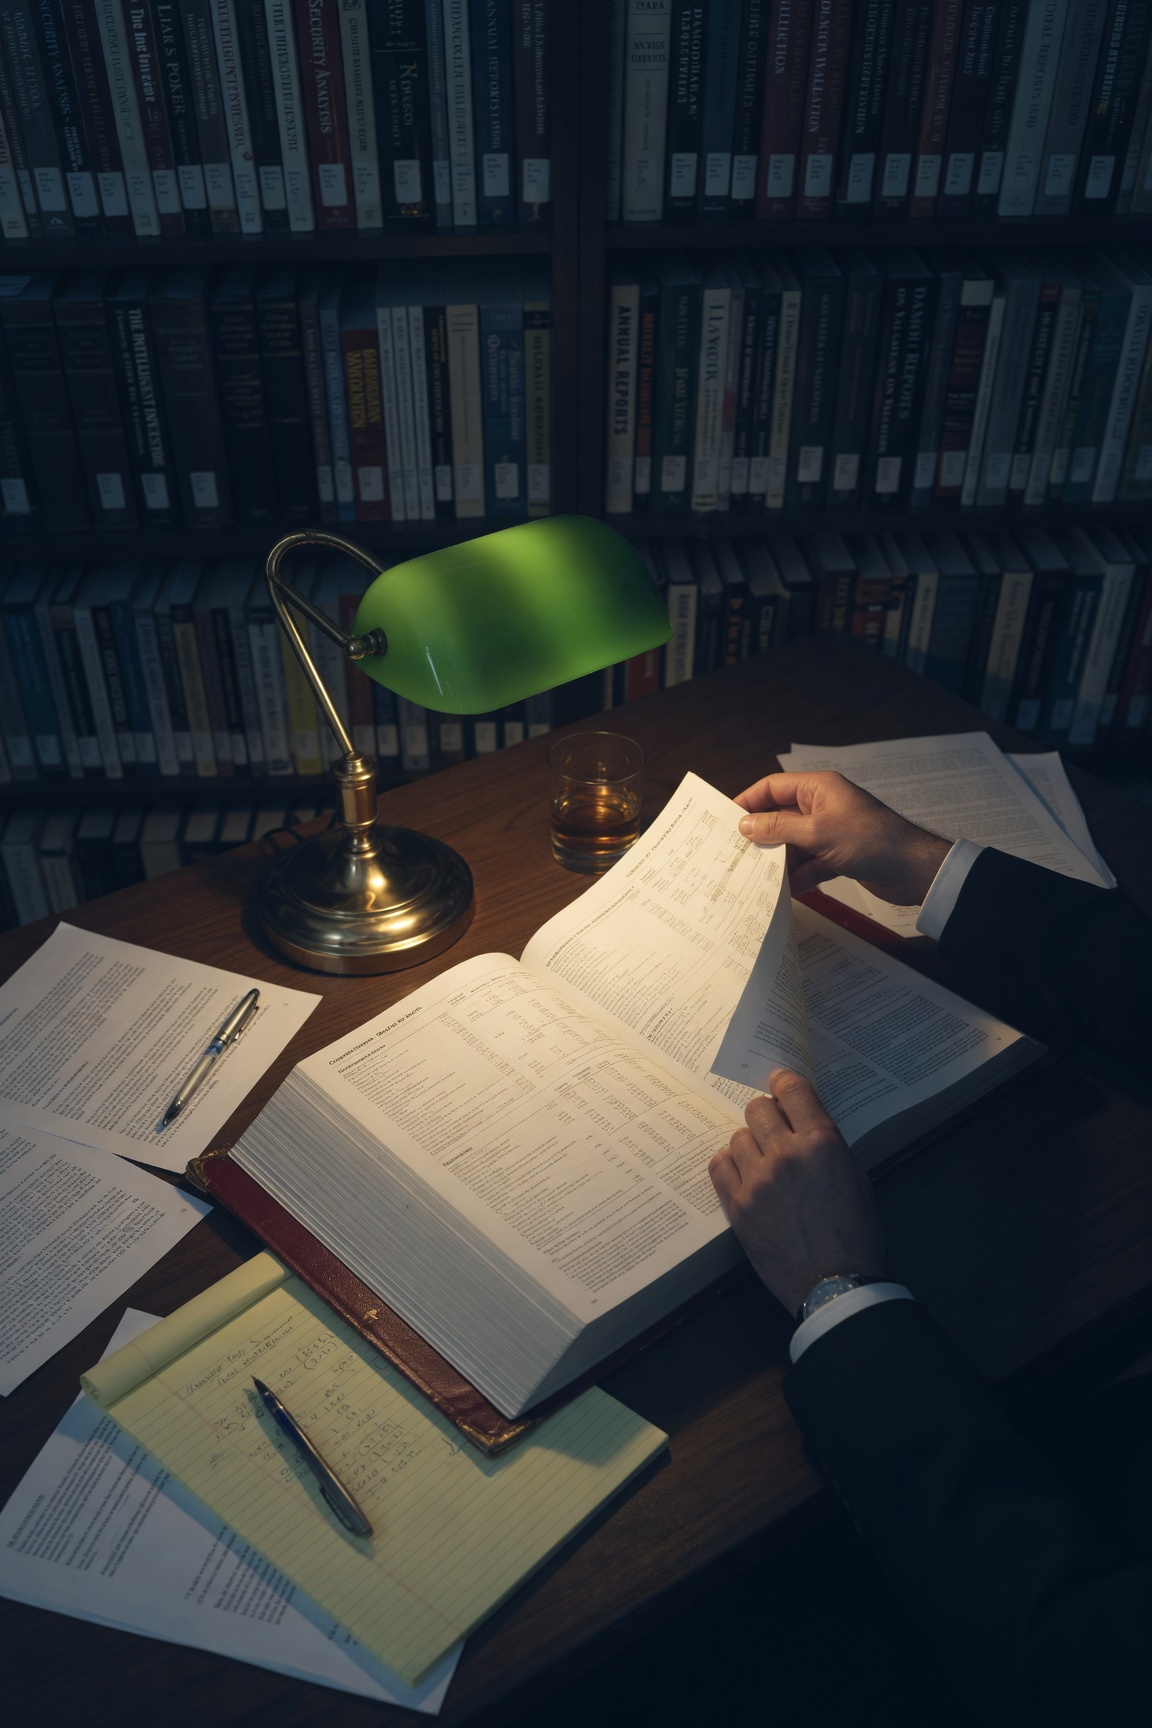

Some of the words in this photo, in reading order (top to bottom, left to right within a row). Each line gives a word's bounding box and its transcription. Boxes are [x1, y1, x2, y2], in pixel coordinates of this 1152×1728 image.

[166, 62, 186, 115] POKER
[616, 305, 632, 364] ANNUAL
[614, 371, 631, 435] REPORTS
